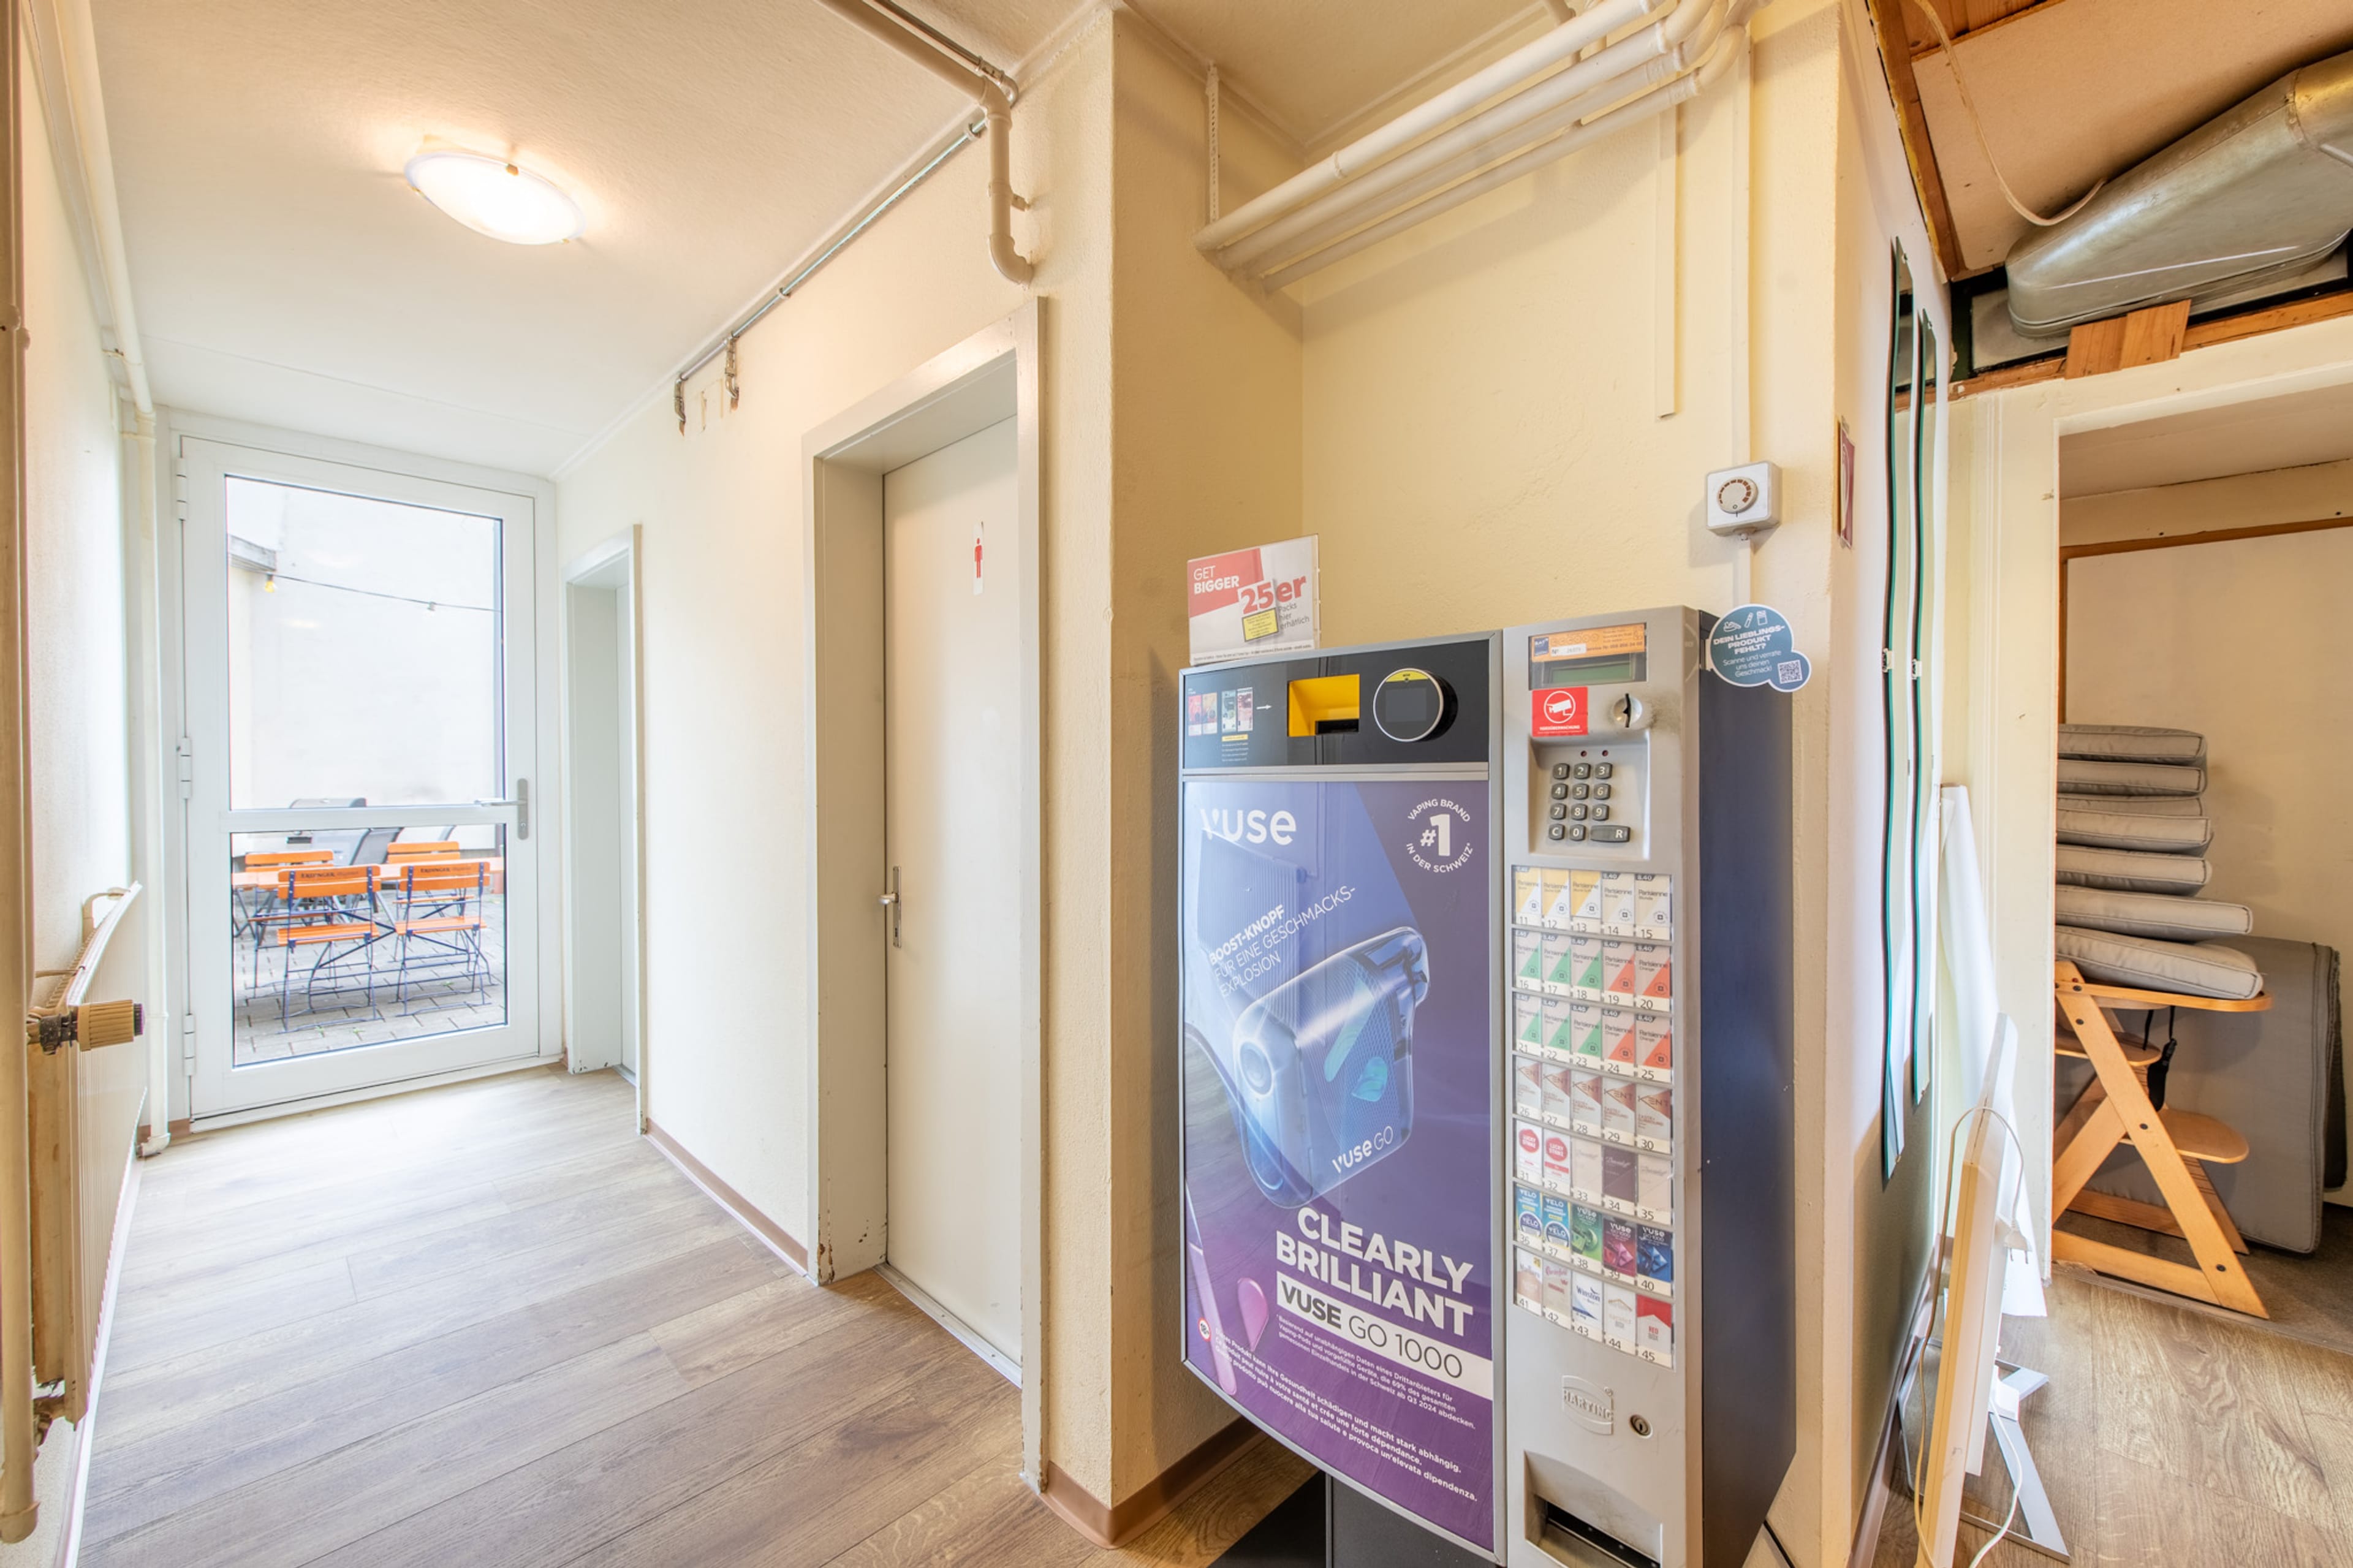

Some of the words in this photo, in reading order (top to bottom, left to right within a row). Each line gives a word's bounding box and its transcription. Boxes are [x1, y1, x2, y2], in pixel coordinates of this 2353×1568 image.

[1194, 566, 1216, 580] GET
[1194, 575, 1240, 594] BIGGER
[1241, 576, 1306, 614] 25er
[1713, 635, 1733, 645] DEIN
[1735, 625, 1785, 641] LIEBLINGS-
[1728, 635, 1771, 649] PRODUKT
[1735, 643, 1766, 654] FEHLT?
[1723, 657, 1745, 666] Scanne
[1748, 659, 1769, 668] deinen
[1408, 799, 1438, 820] VAPING
[1440, 799, 1470, 822] BRAND
[1574, 808, 1580, 816] 8
[1596, 808, 1602, 816] 9
[1420, 814, 1450, 856] #1
[1616, 829, 1623, 838] R
[1406, 843, 1415, 854] IN
[1413, 854, 1431, 870] DER
[1520, 917, 1528, 925] 11
[1548, 920, 1557, 928] 12
[1577, 923, 1586, 932] 13
[1608, 926, 1618, 934] 14
[1209, 904, 1284, 966] BOOST-KNOPF
[1215, 959, 1235, 982] FÜR
[1235, 942, 1262, 967] EINE
[1263, 885, 1355, 949] GESCHMACKS-
[1641, 930, 1652, 939] 15
[1220, 951, 1281, 997] EXPLOSION
[1520, 980, 1528, 989] 16
[1549, 985, 1557, 994] 17
[1578, 990, 1587, 999] 18
[1608, 994, 1619, 1004] 19
[1641, 999, 1653, 1009] 20
[1519, 1043, 1528, 1053] 21
[1547, 1050, 1556, 1059] 22
[1577, 1056, 1587, 1066] 23
[1608, 1064, 1620, 1073] 24
[1642, 1069, 1654, 1080] 25
[1520, 1107, 1529, 1116] 26
[1547, 1115, 1557, 1125] 27
[1576, 1123, 1587, 1134] 28
[1373, 1126, 1393, 1151] GO
[1608, 1131, 1620, 1142] 29
[1642, 1139, 1654, 1150] 30
[1520, 1170, 1529, 1181] 31
[1547, 1180, 1557, 1189] 32
[1577, 1191, 1588, 1201] 33
[1608, 1200, 1620, 1211] 34
[1642, 1209, 1654, 1221] 35
[1520, 1235, 1529, 1245] 36
[1298, 1207, 1474, 1295] CLEARLY
[1548, 1246, 1558, 1256] 37
[1578, 1258, 1588, 1268] 38
[1609, 1270, 1620, 1280] 39
[1276, 1230, 1474, 1337] BRILLIANT
[1642, 1280, 1654, 1291] 40
[1577, 1285, 1600, 1301] Winston
[1520, 1298, 1528, 1307] 41
[1548, 1312, 1558, 1322] 42
[1281, 1280, 1342, 1330] VUSE
[1349, 1316, 1387, 1347] GO
[1395, 1333, 1462, 1378] 1000
[1577, 1326, 1589, 1336] 43
[1609, 1338, 1621, 1348] 44
[1642, 1350, 1655, 1361] 45
[1313, 1343, 1324, 1352] und
[1380, 1375, 1390, 1384] die
[1408, 1387, 1420, 1397] des
[1356, 1355, 1374, 1369] Daten
[1376, 1365, 1392, 1377] eines
[1394, 1372, 1441, 1398] Drittanbieters
[1442, 1393, 1453, 1402] für
[1232, 1340, 1252, 1359] Produkt
[1252, 1355, 1267, 1368] kann
[1267, 1365, 1279, 1377] Ihre
[1280, 1374, 1316, 1399] Gesundheit
[1317, 1396, 1352, 1420] schädigen
[1354, 1416, 1368, 1428] und
[1370, 1425, 1395, 1442] macht
[1396, 1438, 1417, 1452] stark
[1419, 1449, 1461, 1473] abhängig.
[1358, 1373, 1368, 1382] der
[1370, 1379, 1395, 1395] Schweiz
[1397, 1390, 1406, 1399] ab
[1419, 1400, 1436, 1414] 2024
[1438, 1409, 1477, 1430] abdecken.
[1564, 1389, 1613, 1420] HARTING
[1241, 1357, 1254, 1369] peut
[1255, 1366, 1269, 1380] nuire
[1275, 1380, 1291, 1394] votre
[1292, 1391, 1309, 1405] santé
[1319, 1407, 1335, 1420] crée
[1336, 1416, 1349, 1428] une
[1351, 1423, 1369, 1438] forte
[1371, 1434, 1422, 1466] dépendance.
[1295, 1402, 1306, 1413] alla
[1308, 1409, 1319, 1421] tua
[1320, 1417, 1341, 1433] salute
[1349, 1433, 1379, 1454] provoca
[1423, 1471, 1477, 1502] dipendenza.
